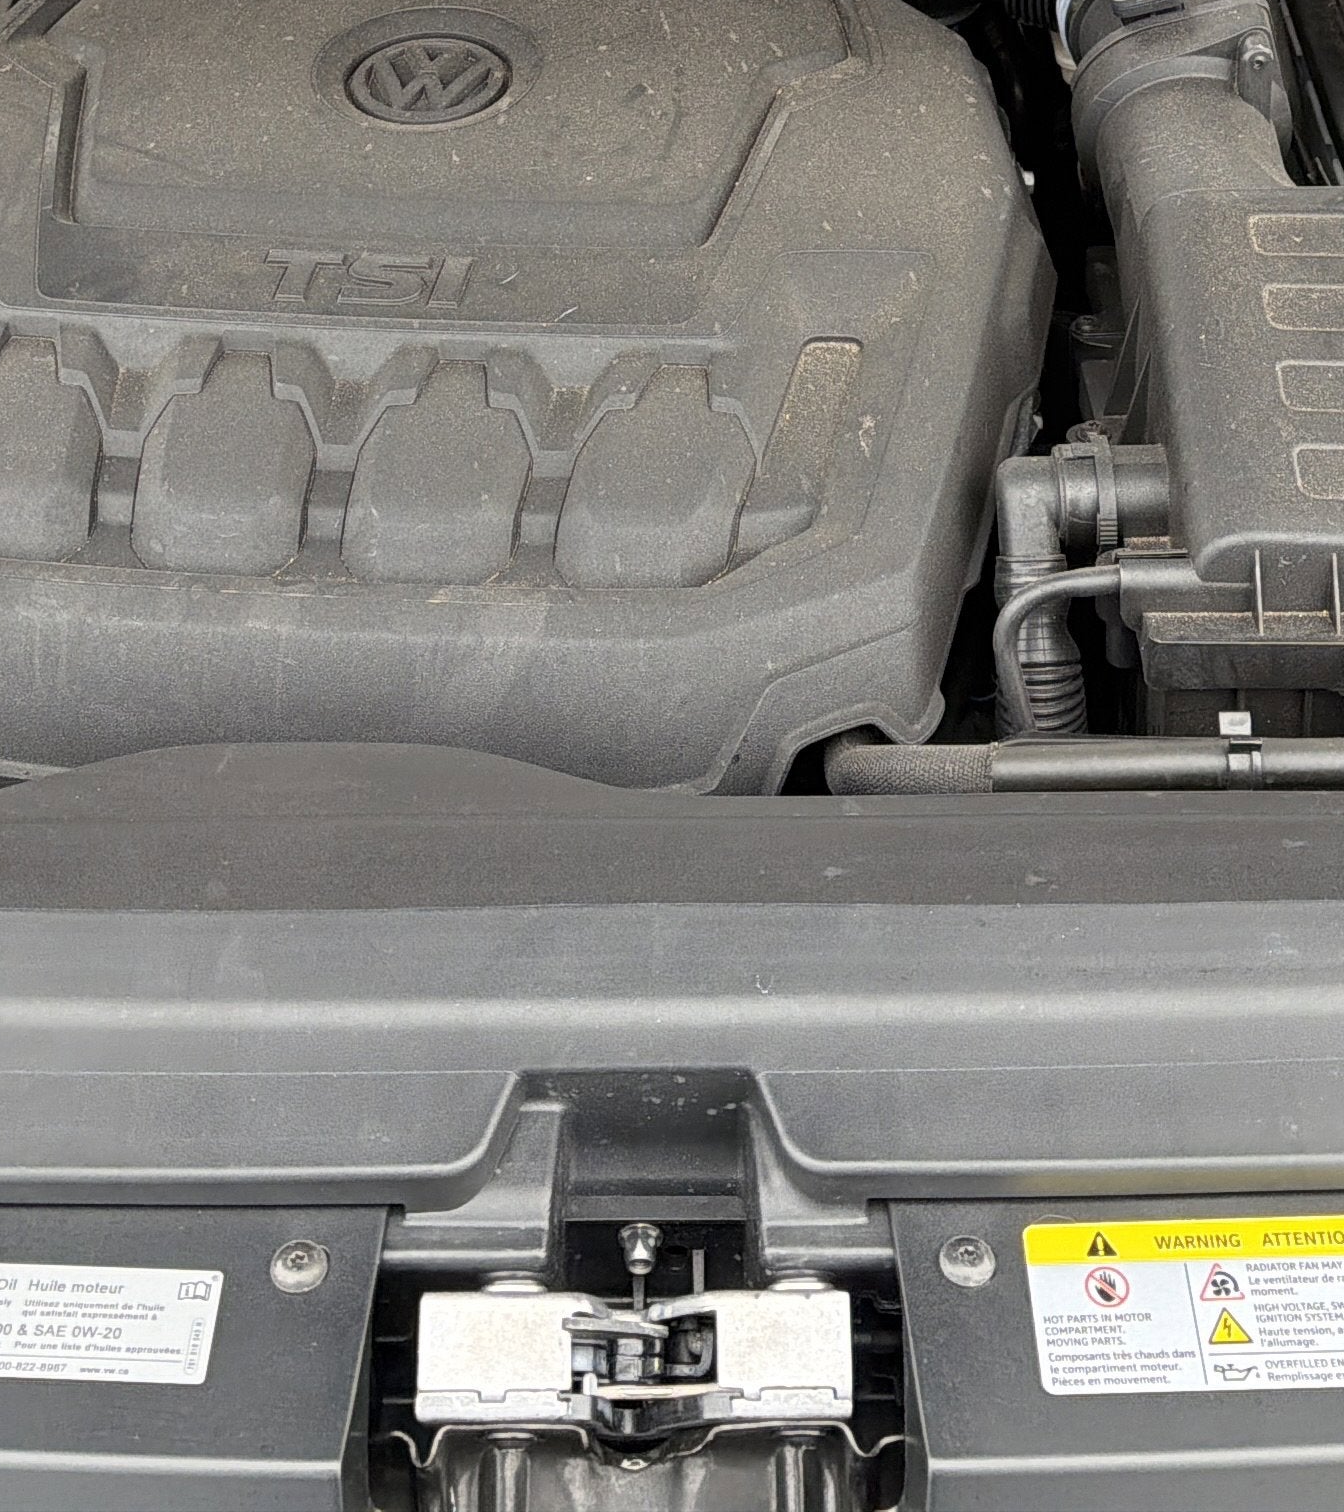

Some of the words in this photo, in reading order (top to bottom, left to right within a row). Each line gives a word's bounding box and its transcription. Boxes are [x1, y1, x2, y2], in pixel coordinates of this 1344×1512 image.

[346, 34, 511, 122] VW
[265, 249, 474, 309] TSI
[1154, 1233, 1242, 1250] WARNING
[1246, 1262, 1297, 1272] RADIATOR
[1299, 1261, 1319, 1271] FAN
[1321, 1260, 1342, 1270] MAY
[1248, 1276, 1261, 1286] Le
[1263, 1274, 1318, 1285] ventilateur
[1321, 1274, 1335, 1283] de
[29, 1279, 66, 1293] Huile
[71, 1282, 125, 1294] moteur
[1250, 1287, 1298, 1297] moment.
[63, 1301, 119, 1310] uniquement
[122, 1303, 133, 1311] de
[1253, 1303, 1279, 1312] HIGH
[1282, 1301, 1330, 1312] VOLTAGE,
[1044, 1315, 1064, 1325] HOT
[1067, 1314, 1099, 1324] PARTS
[1101, 1313, 1112, 1322] IN
[1114, 1312, 1152, 1322] MOTOR
[1256, 1313, 1302, 1323] IGNITION
[17, 1323, 27, 1336] &
[34, 1324, 68, 1337] SAE
[72, 1325, 122, 1339] 0W-20
[1045, 1325, 1127, 1336] COMPARTMENT.
[1259, 1327, 1290, 1337] Haute
[1293, 1326, 1335, 1336] tension,
[14, 1341, 37, 1349] Pour
[40, 1342, 58, 1350] une
[61, 1343, 81, 1351] liste
[1046, 1337, 1089, 1347] MOVING
[1091, 1336, 1127, 1346] PARTS.
[1049, 1351, 1111, 1363] Composants
[1113, 1349, 1132, 1360] très
[1134, 1349, 1170, 1360] chauds
[1172, 1348, 1196, 1359] dans
[1050, 1364, 1060, 1374] le
[1062, 1363, 1138, 1376] compartiment
[1140, 1362, 1182, 1372] moteur.
[1265, 1359, 1329, 1369] OVERFILLED
[1052, 1375, 1085, 1386] Pièces
[1088, 1377, 1101, 1385] en
[1103, 1375, 1172, 1385] mouvement.
[1267, 1371, 1333, 1383] Remplissage
